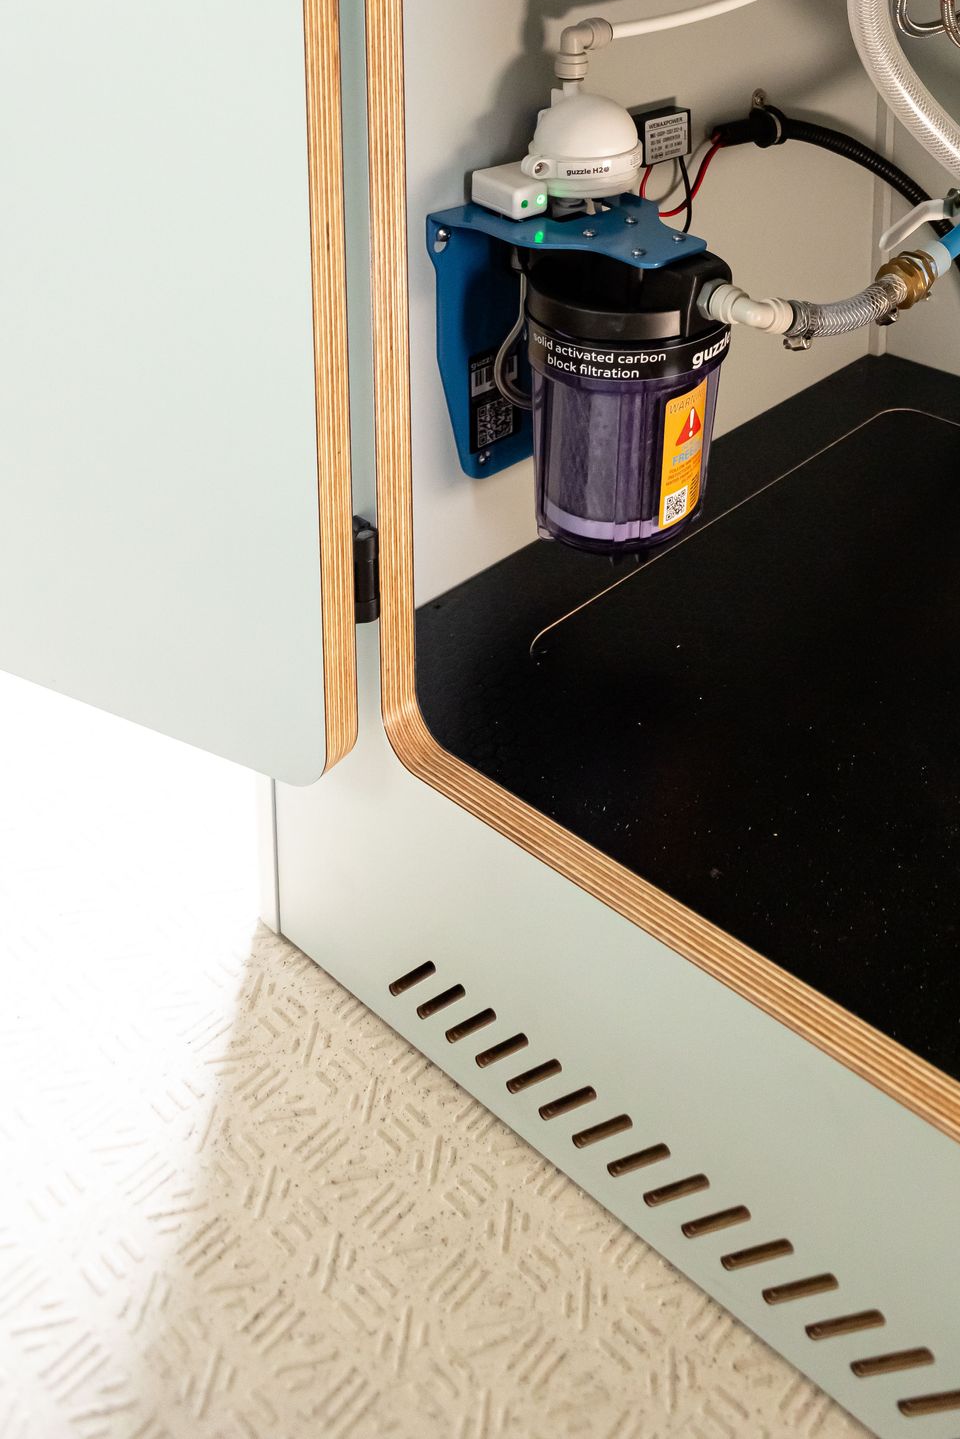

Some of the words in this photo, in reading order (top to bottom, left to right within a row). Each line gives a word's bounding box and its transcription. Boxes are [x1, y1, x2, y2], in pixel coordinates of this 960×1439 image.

[566, 168, 591, 177] guzzle
[533, 333, 553, 350] solid
[555, 344, 614, 364] activated
[617, 352, 667, 364] carbon
[547, 354, 577, 373] block
[579, 364, 640, 379] filtration
